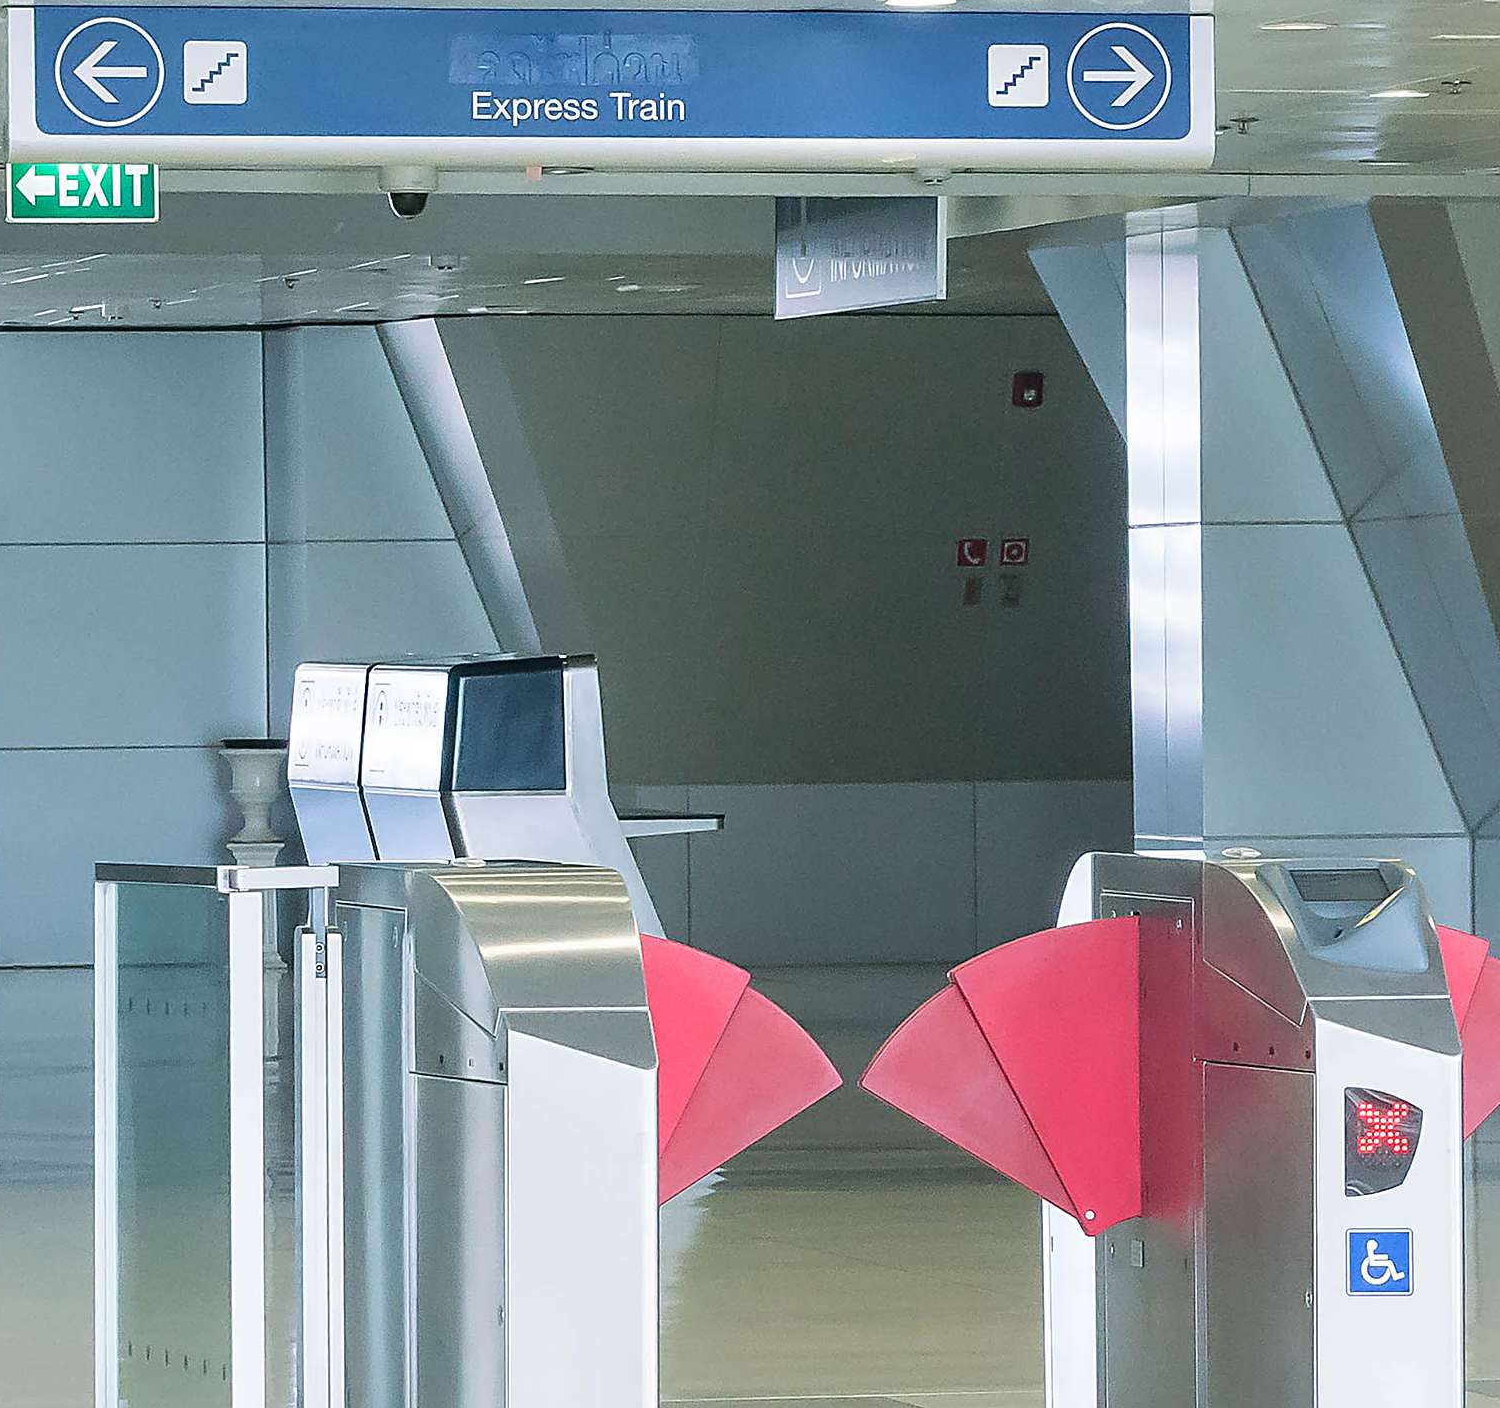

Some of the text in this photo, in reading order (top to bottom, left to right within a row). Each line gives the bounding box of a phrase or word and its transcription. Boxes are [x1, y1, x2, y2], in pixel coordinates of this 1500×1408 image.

[471, 91, 686, 127] Express Train
[58, 164, 149, 207] EXIT
